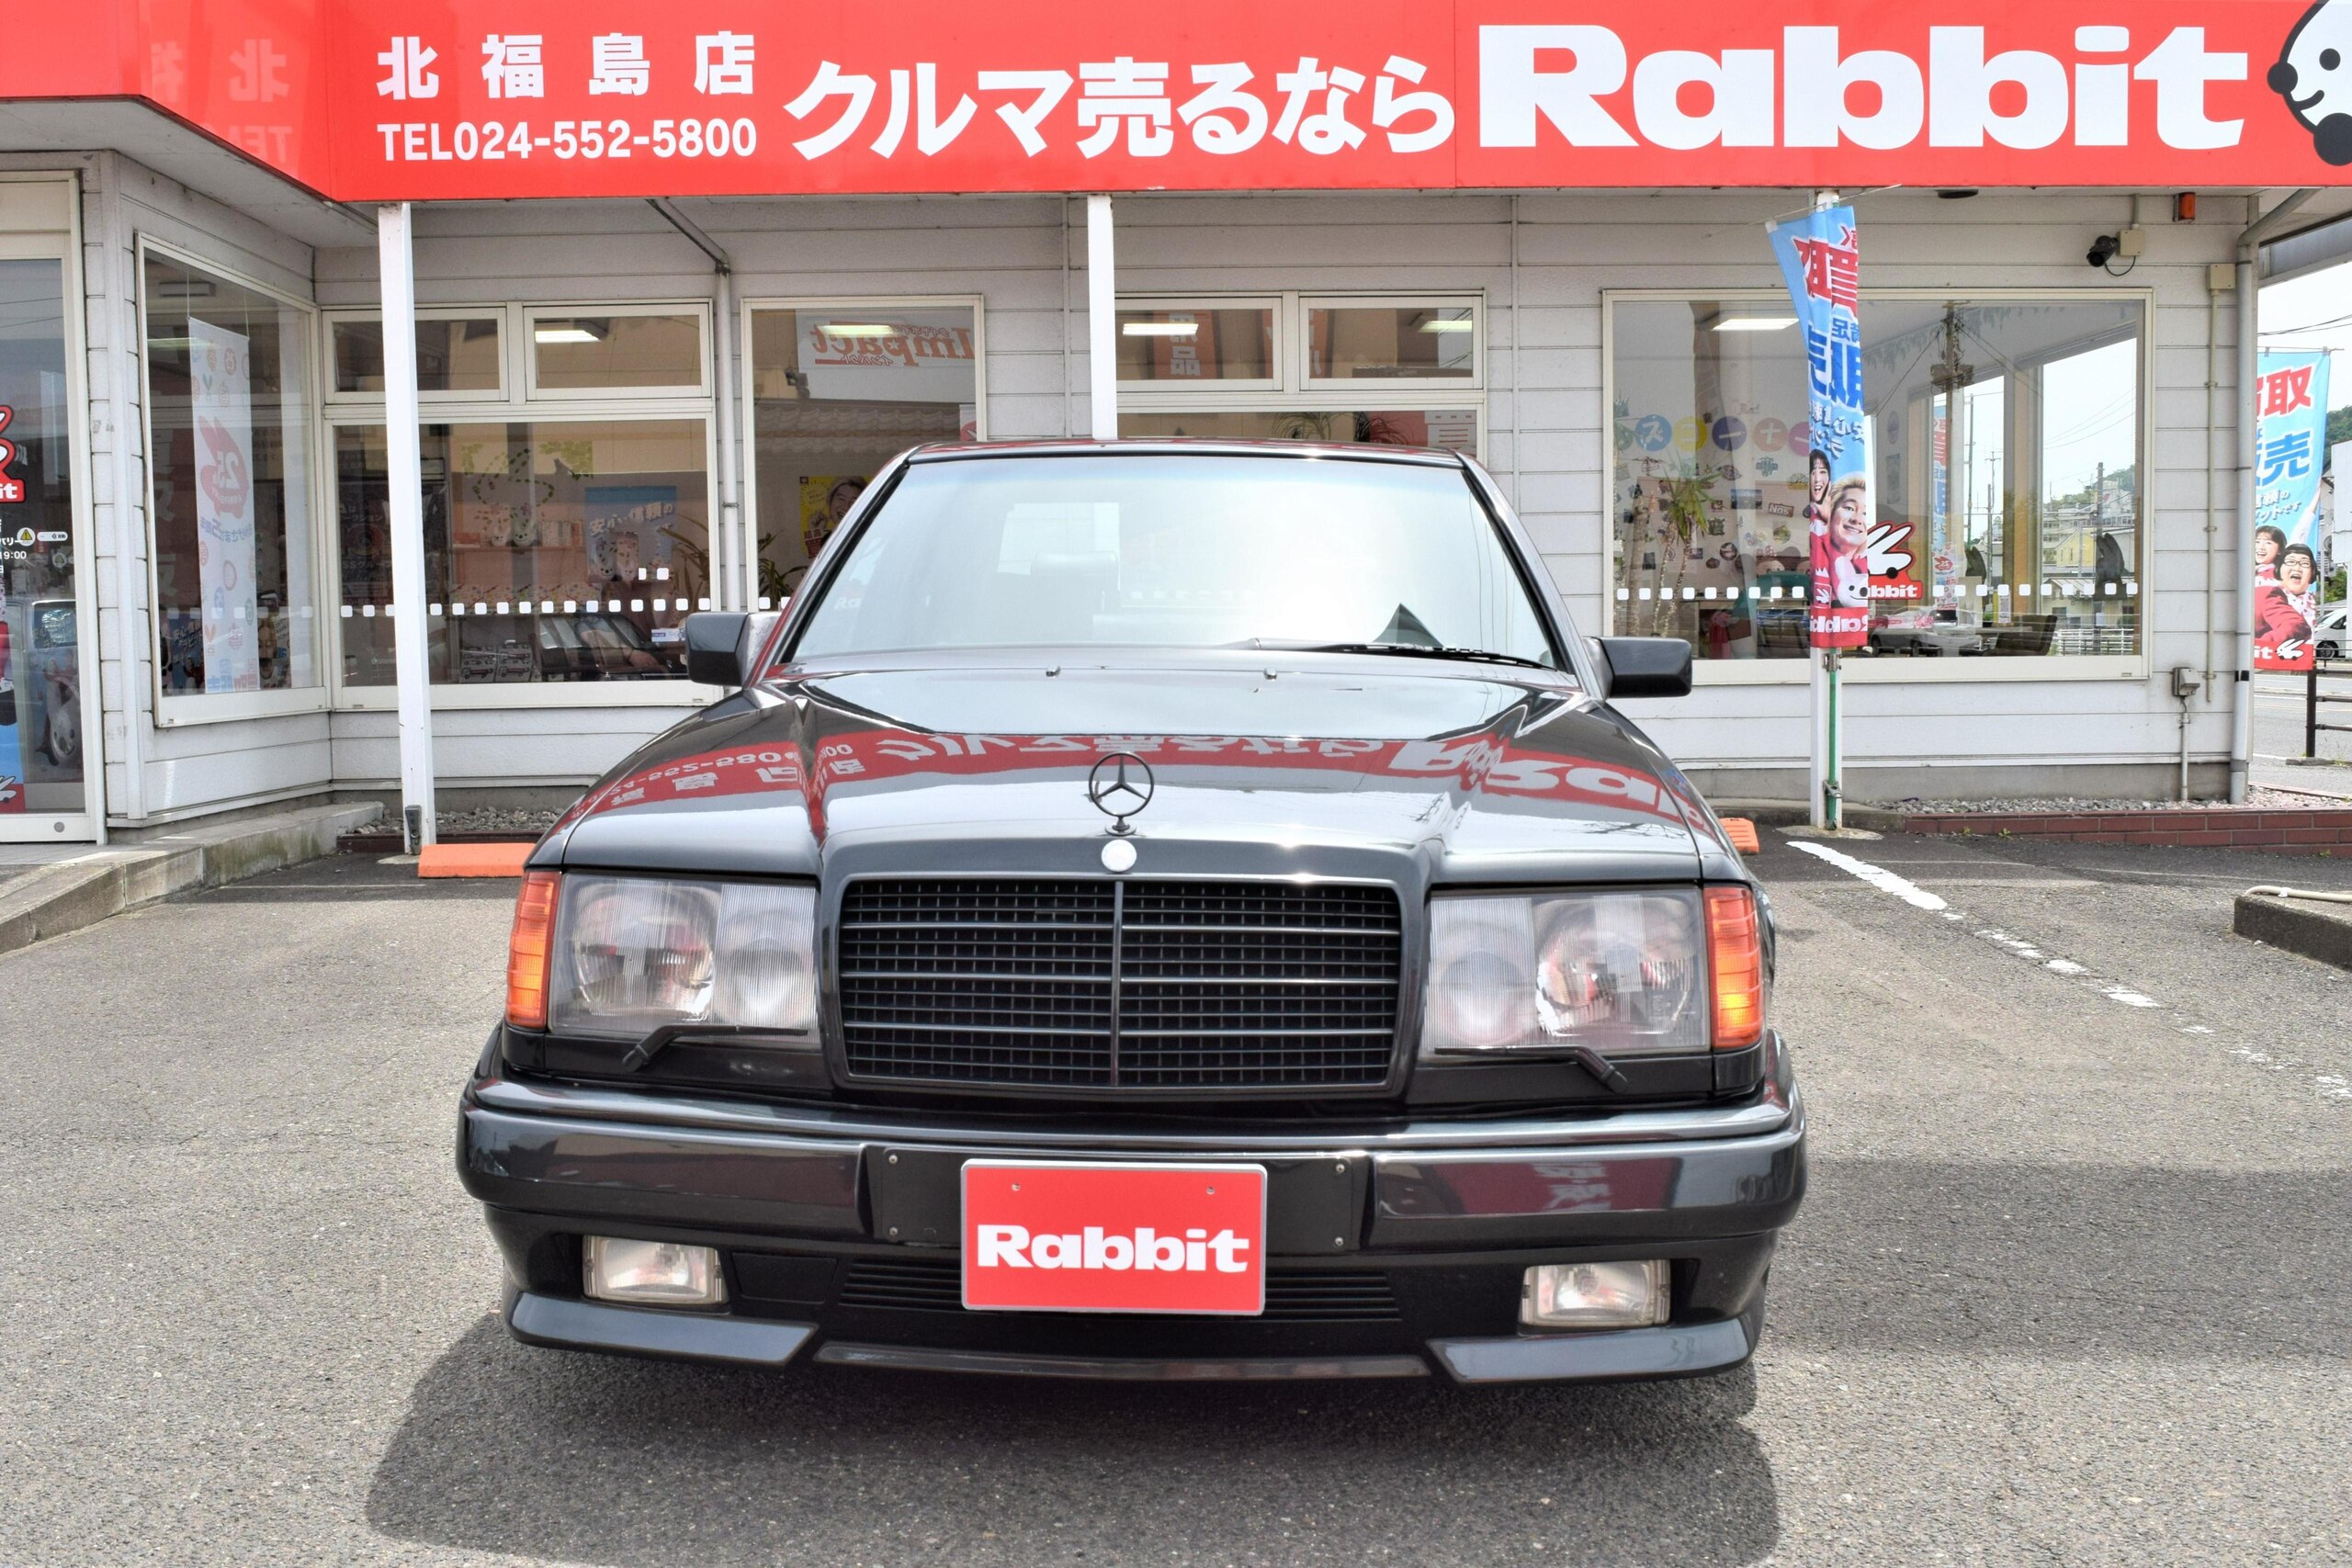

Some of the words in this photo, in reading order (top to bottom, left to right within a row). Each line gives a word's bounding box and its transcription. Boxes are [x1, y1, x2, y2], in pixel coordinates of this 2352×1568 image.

[377, 30, 756, 100] 北福島店
[1479, 25, 2248, 150] Rabbit
[783, 56, 1457, 161] クルマ売るなら
[378, 118, 757, 161] TEL024-552-5800
[2256, 367, 2312, 417] 取
[2256, 430, 2311, 486] 売
[0, 551, 27, 559] 9:00
[1868, 584, 1917, 598] bbit
[978, 1224, 1250, 1272] Rabbit
